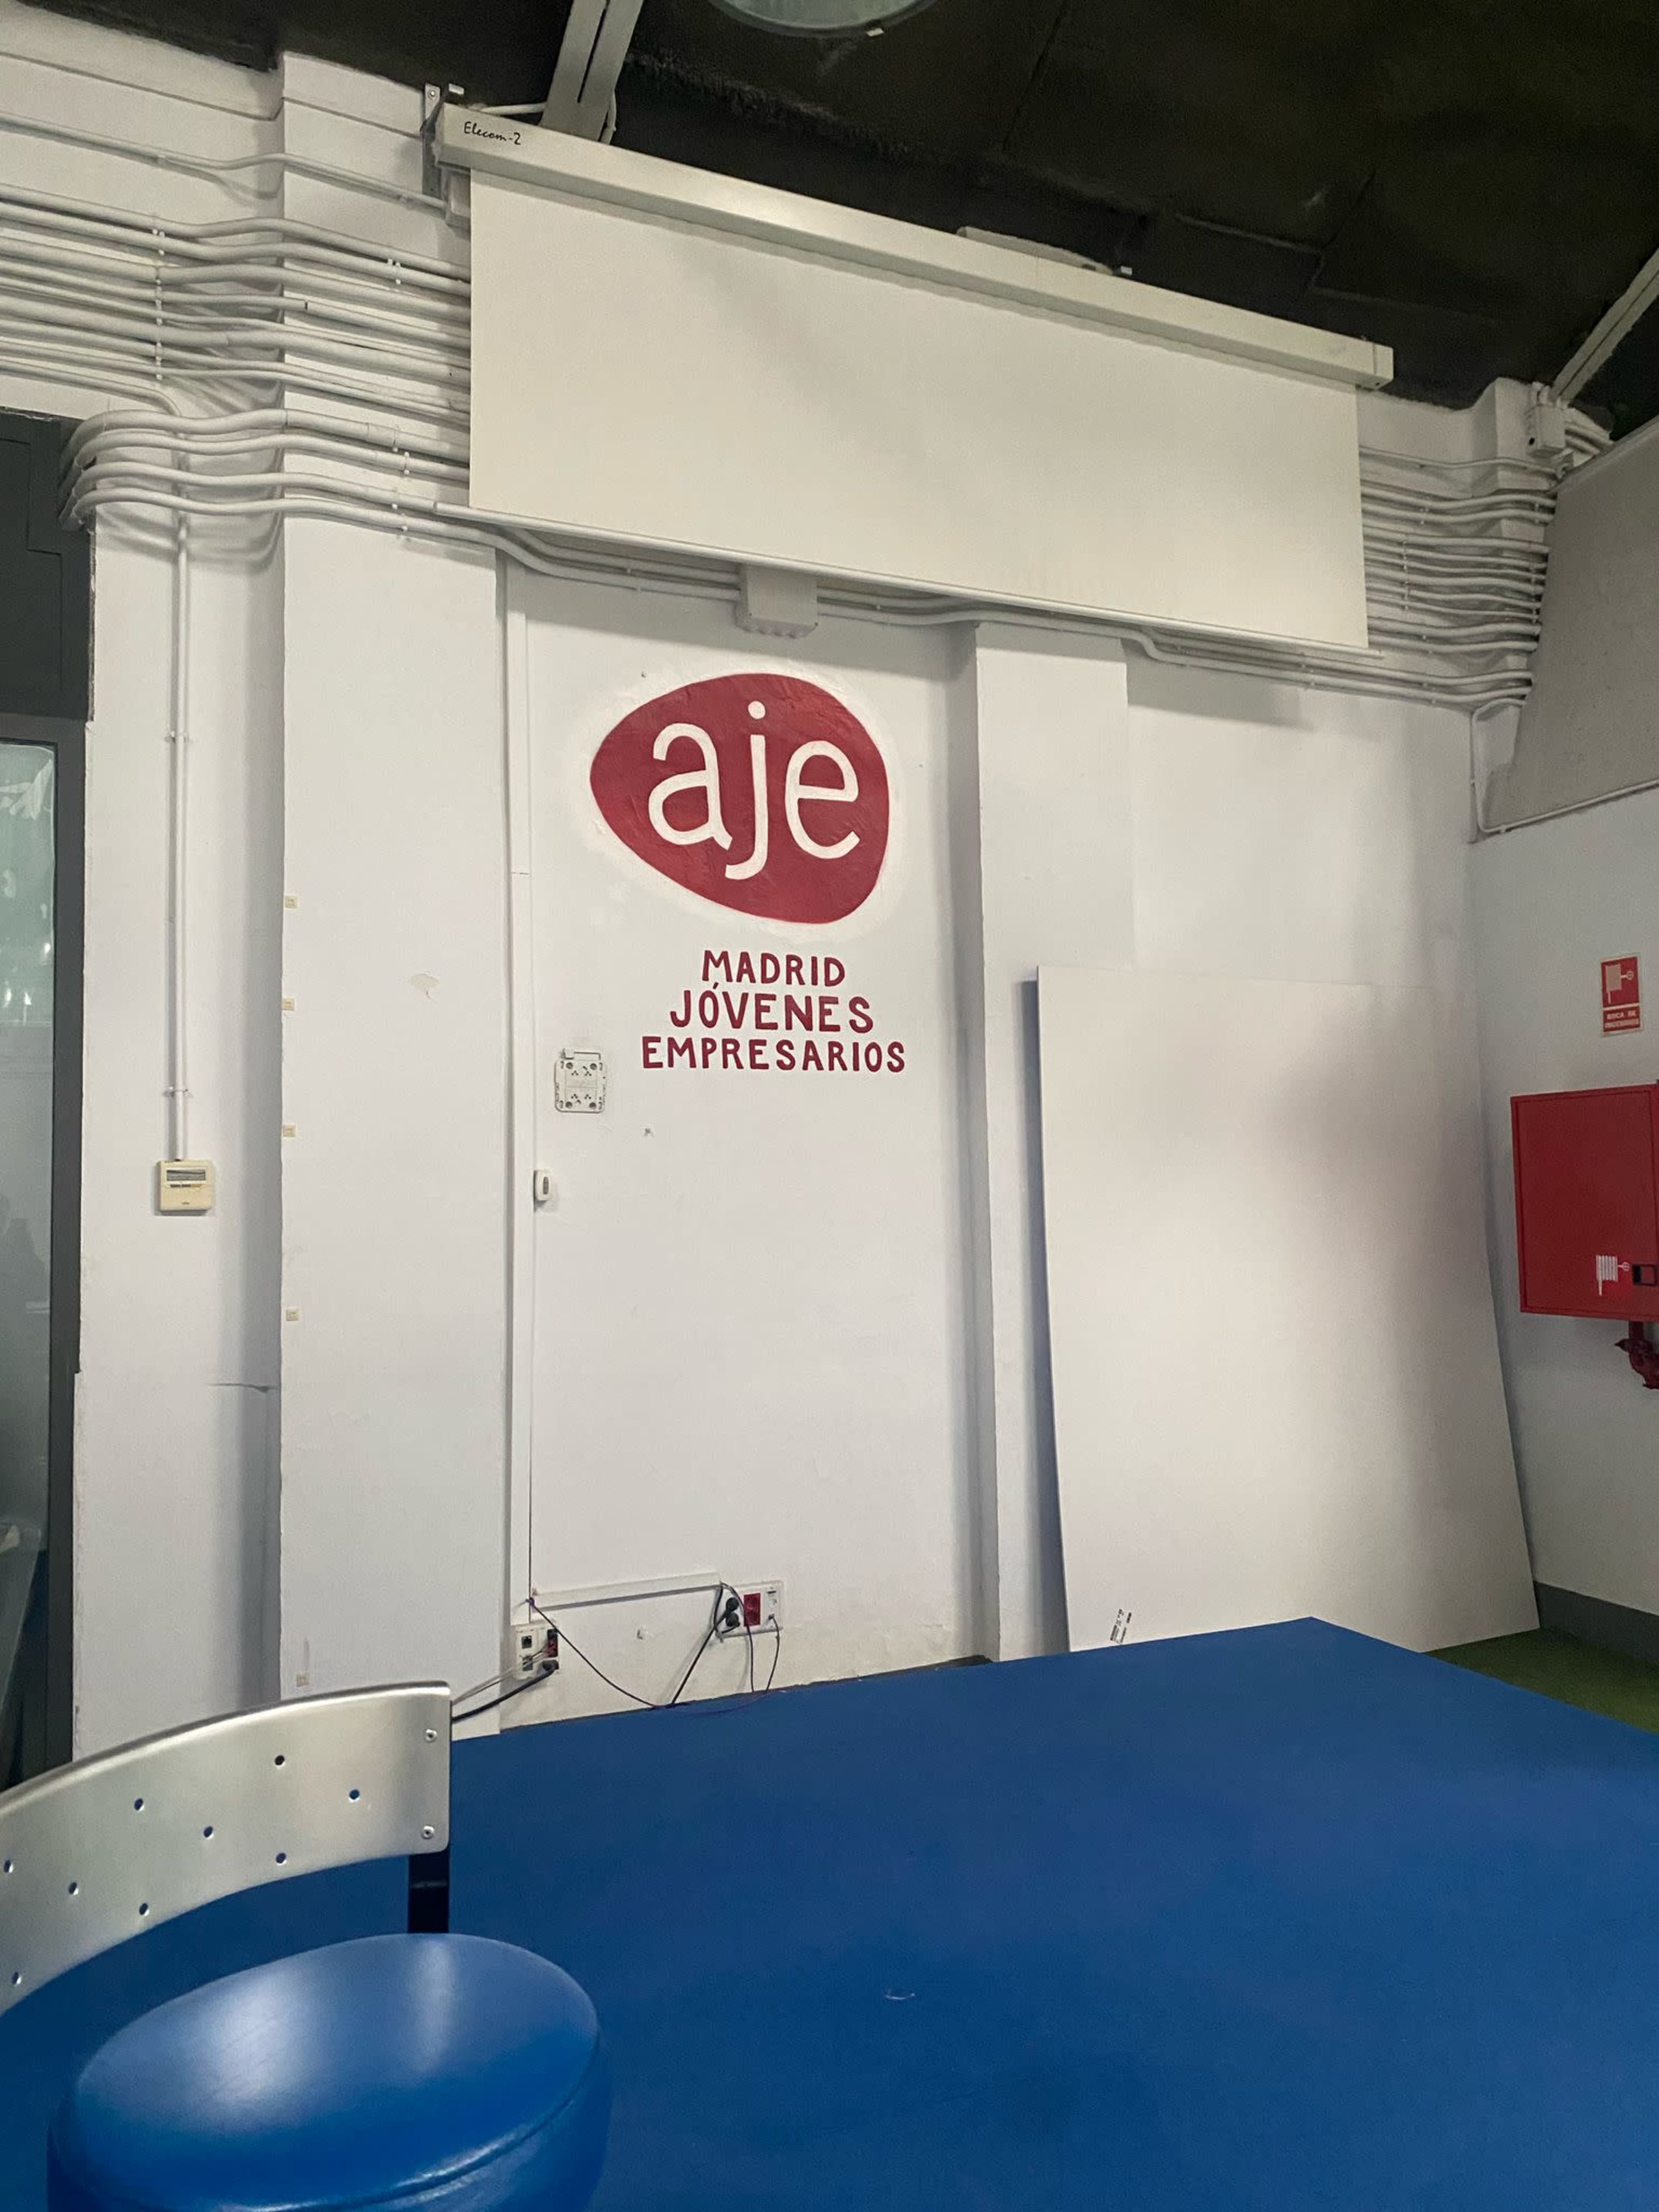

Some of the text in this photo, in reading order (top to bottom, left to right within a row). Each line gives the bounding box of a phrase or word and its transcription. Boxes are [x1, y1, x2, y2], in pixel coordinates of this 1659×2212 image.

[649, 701, 860, 880] aje
[702, 950, 845, 987] MADRID
[670, 982, 874, 1033] JÓVENES
[642, 1036, 905, 1073] EMPRESARIOS
